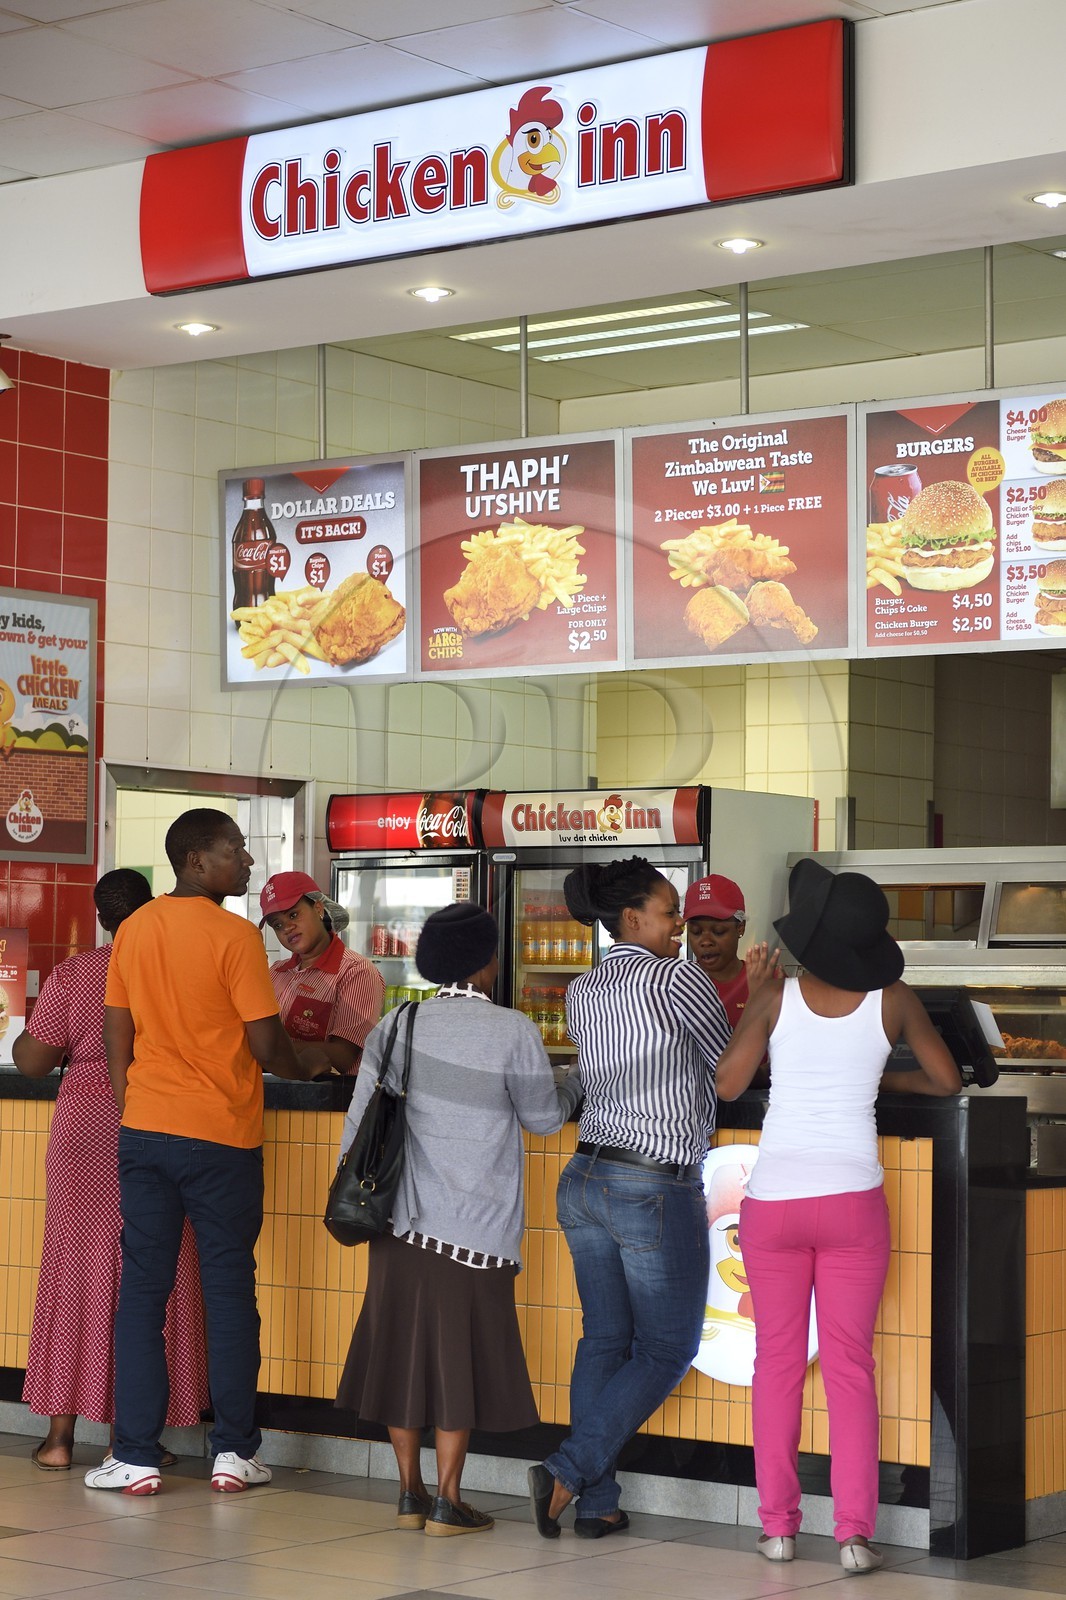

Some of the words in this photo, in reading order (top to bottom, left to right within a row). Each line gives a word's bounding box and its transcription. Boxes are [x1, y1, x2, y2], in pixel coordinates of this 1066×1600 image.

[250, 141, 489, 241] Chicken
[577, 101, 688, 188] inn
[1006, 409, 1048, 427] $4,00
[1006, 427, 1027, 435] Cheese
[1028, 425, 1041, 434] Beef
[1006, 434, 1026, 442] Burger
[688, 438, 718, 454] The
[722, 429, 788, 452] Original
[896, 437, 975, 458] BURGERS
[665, 456, 766, 477] Zimbabwean
[769, 451, 813, 468] Taste
[460, 454, 569, 492] THAPH'
[692, 479, 717, 496] We
[721, 475, 755, 494] Luv!
[465, 488, 561, 518] UTSHIYE
[1006, 486, 1048, 505] $2,50
[271, 498, 338, 520] DOLLAR
[340, 491, 395, 514] DEALS
[654, 511, 662, 522] 2
[665, 508, 704, 521] Piecer
[706, 503, 740, 519] $3.00
[743, 505, 751, 514] +
[754, 506, 759, 514] 1
[760, 503, 785, 513] Piece
[787, 496, 822, 511] FREE
[1028, 504, 1045, 513] Spicy
[1006, 512, 1030, 520] Chicken
[1006, 519, 1026, 527] Burger
[301, 525, 324, 539] IT'S
[325, 522, 361, 537] BACK!
[269, 554, 287, 573] $1
[372, 559, 388, 578] $1
[310, 569, 325, 586] $1
[1006, 564, 1048, 582] $3,50
[577, 594, 599, 604] Piece
[875, 597, 905, 607] Burger,
[952, 592, 993, 610] $4,50
[1006, 590, 1030, 598] Chicken
[557, 604, 581, 615] Large
[582, 603, 607, 614] Chips
[875, 605, 898, 615] Chips
[899, 605, 906, 613] &
[907, 604, 928, 613] Coke
[12, 612, 45, 632] kids,
[568, 620, 584, 628] FOR
[585, 619, 607, 627] ONLY
[874, 619, 908, 630] Chicken
[910, 618, 938, 629] Burger
[952, 616, 993, 634] $2,50
[27, 630, 36, 644] &
[38, 635, 57, 649] get
[59, 637, 88, 651] your
[428, 633, 463, 648] LARGE
[428, 647, 463, 660] CHIPS
[31, 654, 68, 677] little
[32, 697, 68, 711] MEALS
[8, 812, 41, 825] Chicken
[377, 815, 411, 830] enjoy
[511, 802, 598, 833] Chicken
[625, 802, 662, 830] inn
[559, 834, 572, 843] luv
[573, 833, 587, 842] dat
[588, 832, 618, 842] chicken
